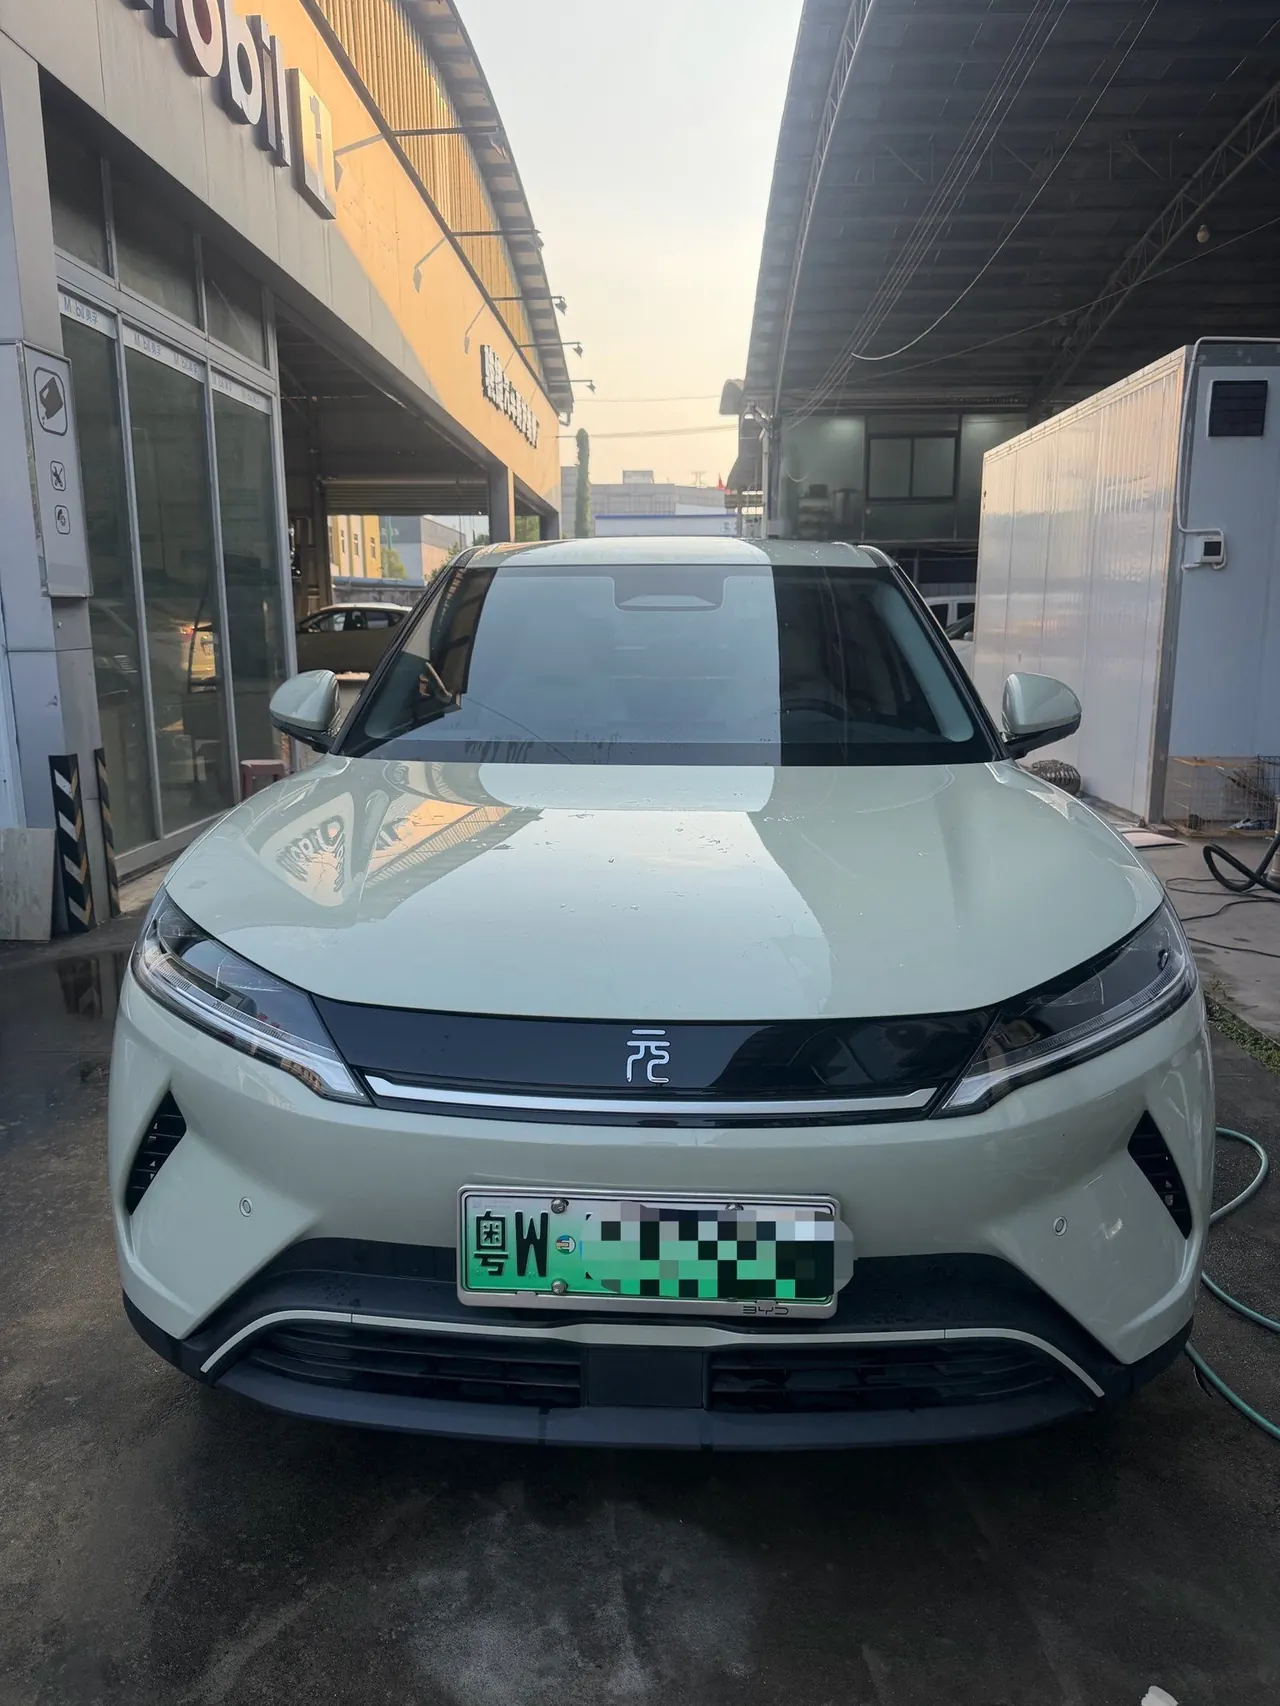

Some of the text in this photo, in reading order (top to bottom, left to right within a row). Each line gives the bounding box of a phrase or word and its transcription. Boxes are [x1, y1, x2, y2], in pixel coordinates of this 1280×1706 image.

[142, 0, 291, 167] obil
[627, 1029, 670, 1083] 元
[743, 1305, 789, 1315] BYD
